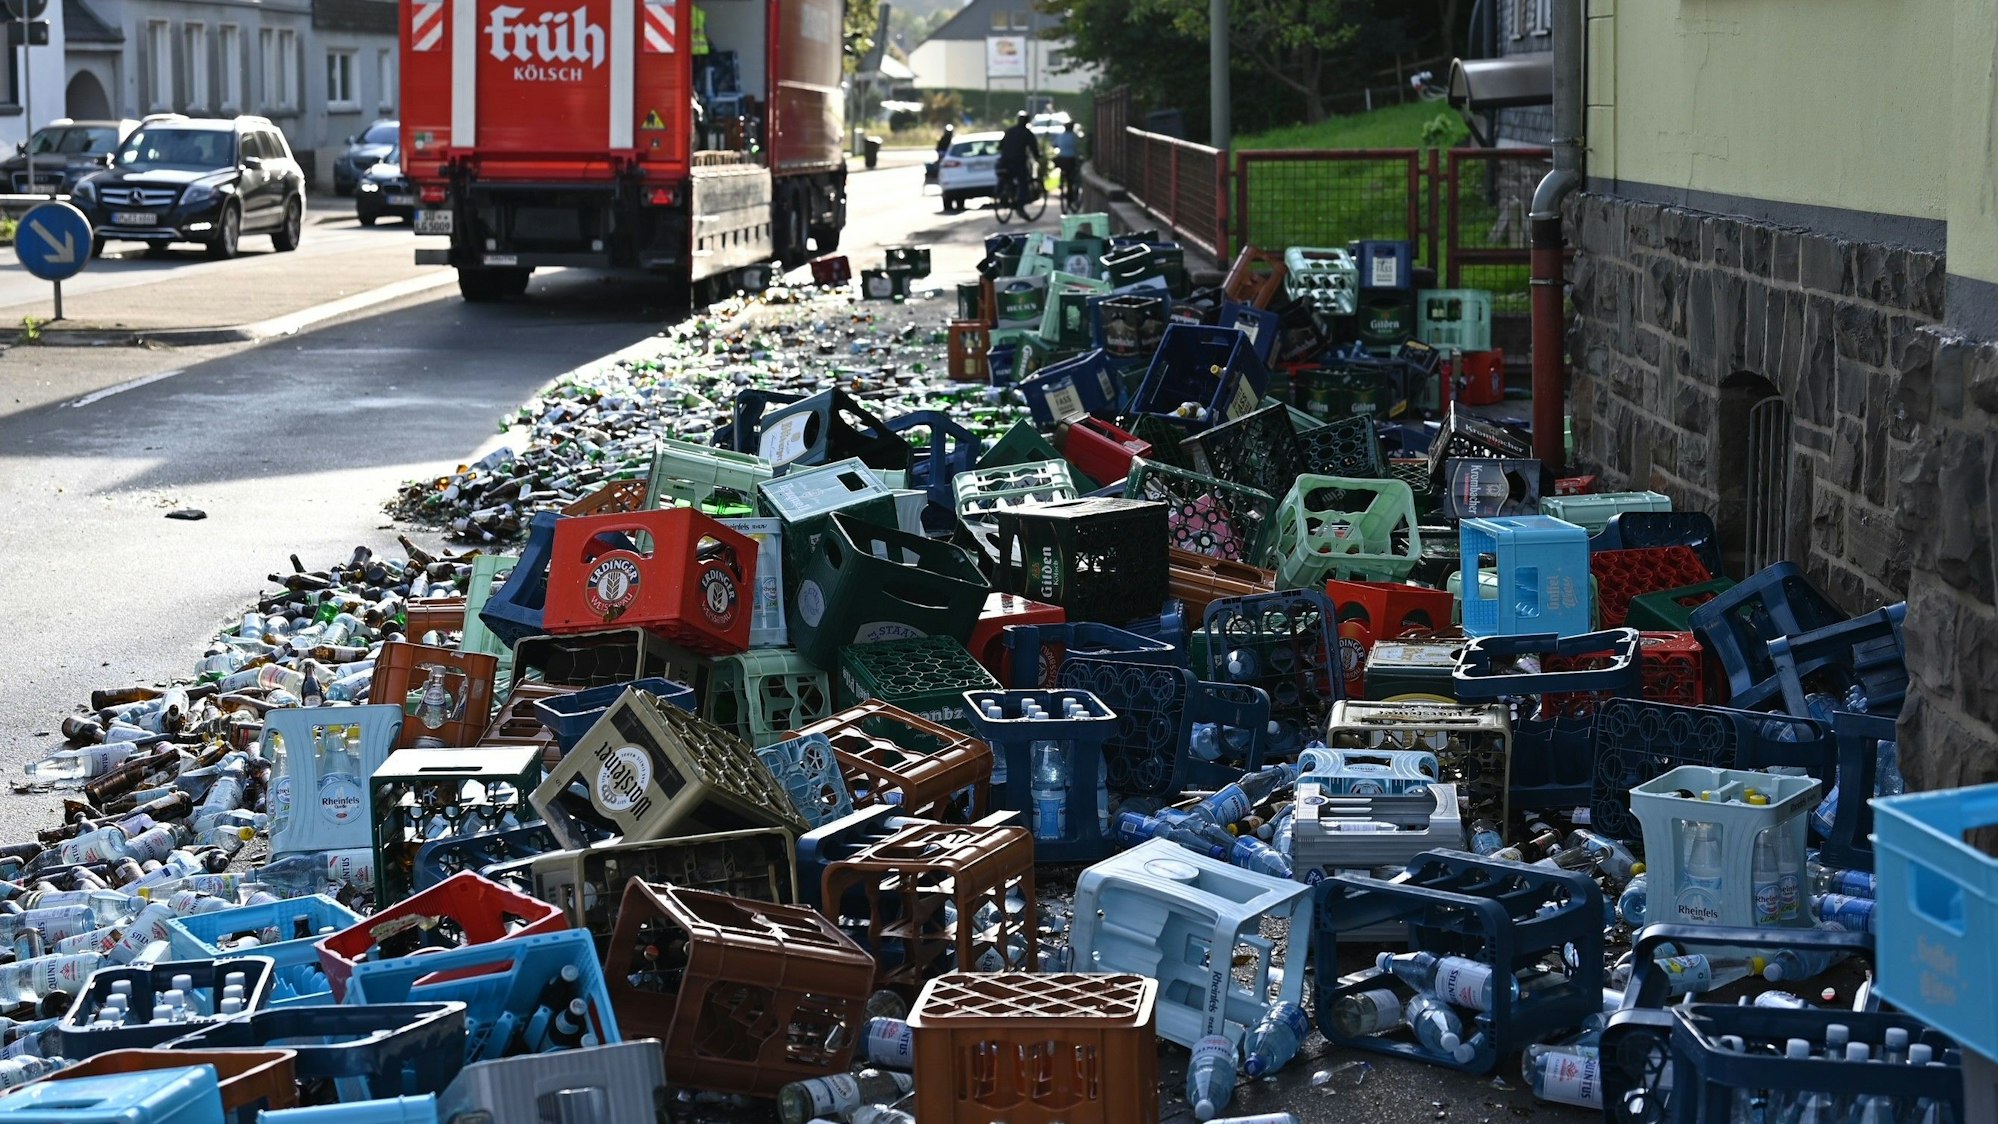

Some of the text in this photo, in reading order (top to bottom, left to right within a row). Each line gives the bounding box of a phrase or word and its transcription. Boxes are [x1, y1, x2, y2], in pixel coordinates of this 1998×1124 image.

[513, 64, 583, 81] KÖLSCH
[1370, 318, 1400, 329] Gilden
[1465, 423, 1524, 453] Krombacher
[1468, 464, 1483, 515] Krombacher
[589, 558, 639, 584] ERDINGER
[701, 568, 736, 600] ERDINGER
[1040, 546, 1053, 599] Gilden
[1339, 639, 1364, 659] DINGER
[594, 741, 652, 822] Warsteiner
[322, 796, 360, 807] Rheinfels
[342, 857, 350, 880] INTUS
[1677, 904, 1719, 919] Rheinfels
[131, 931, 150, 946] NTUS
[47, 959, 58, 990] QUINTU
[1448, 969, 1460, 1000] INTUS
[1207, 970, 1223, 1014] Rheinfels
[899, 1026, 912, 1056] INTUS
[1580, 1059, 1597, 1100] QUINTUS
